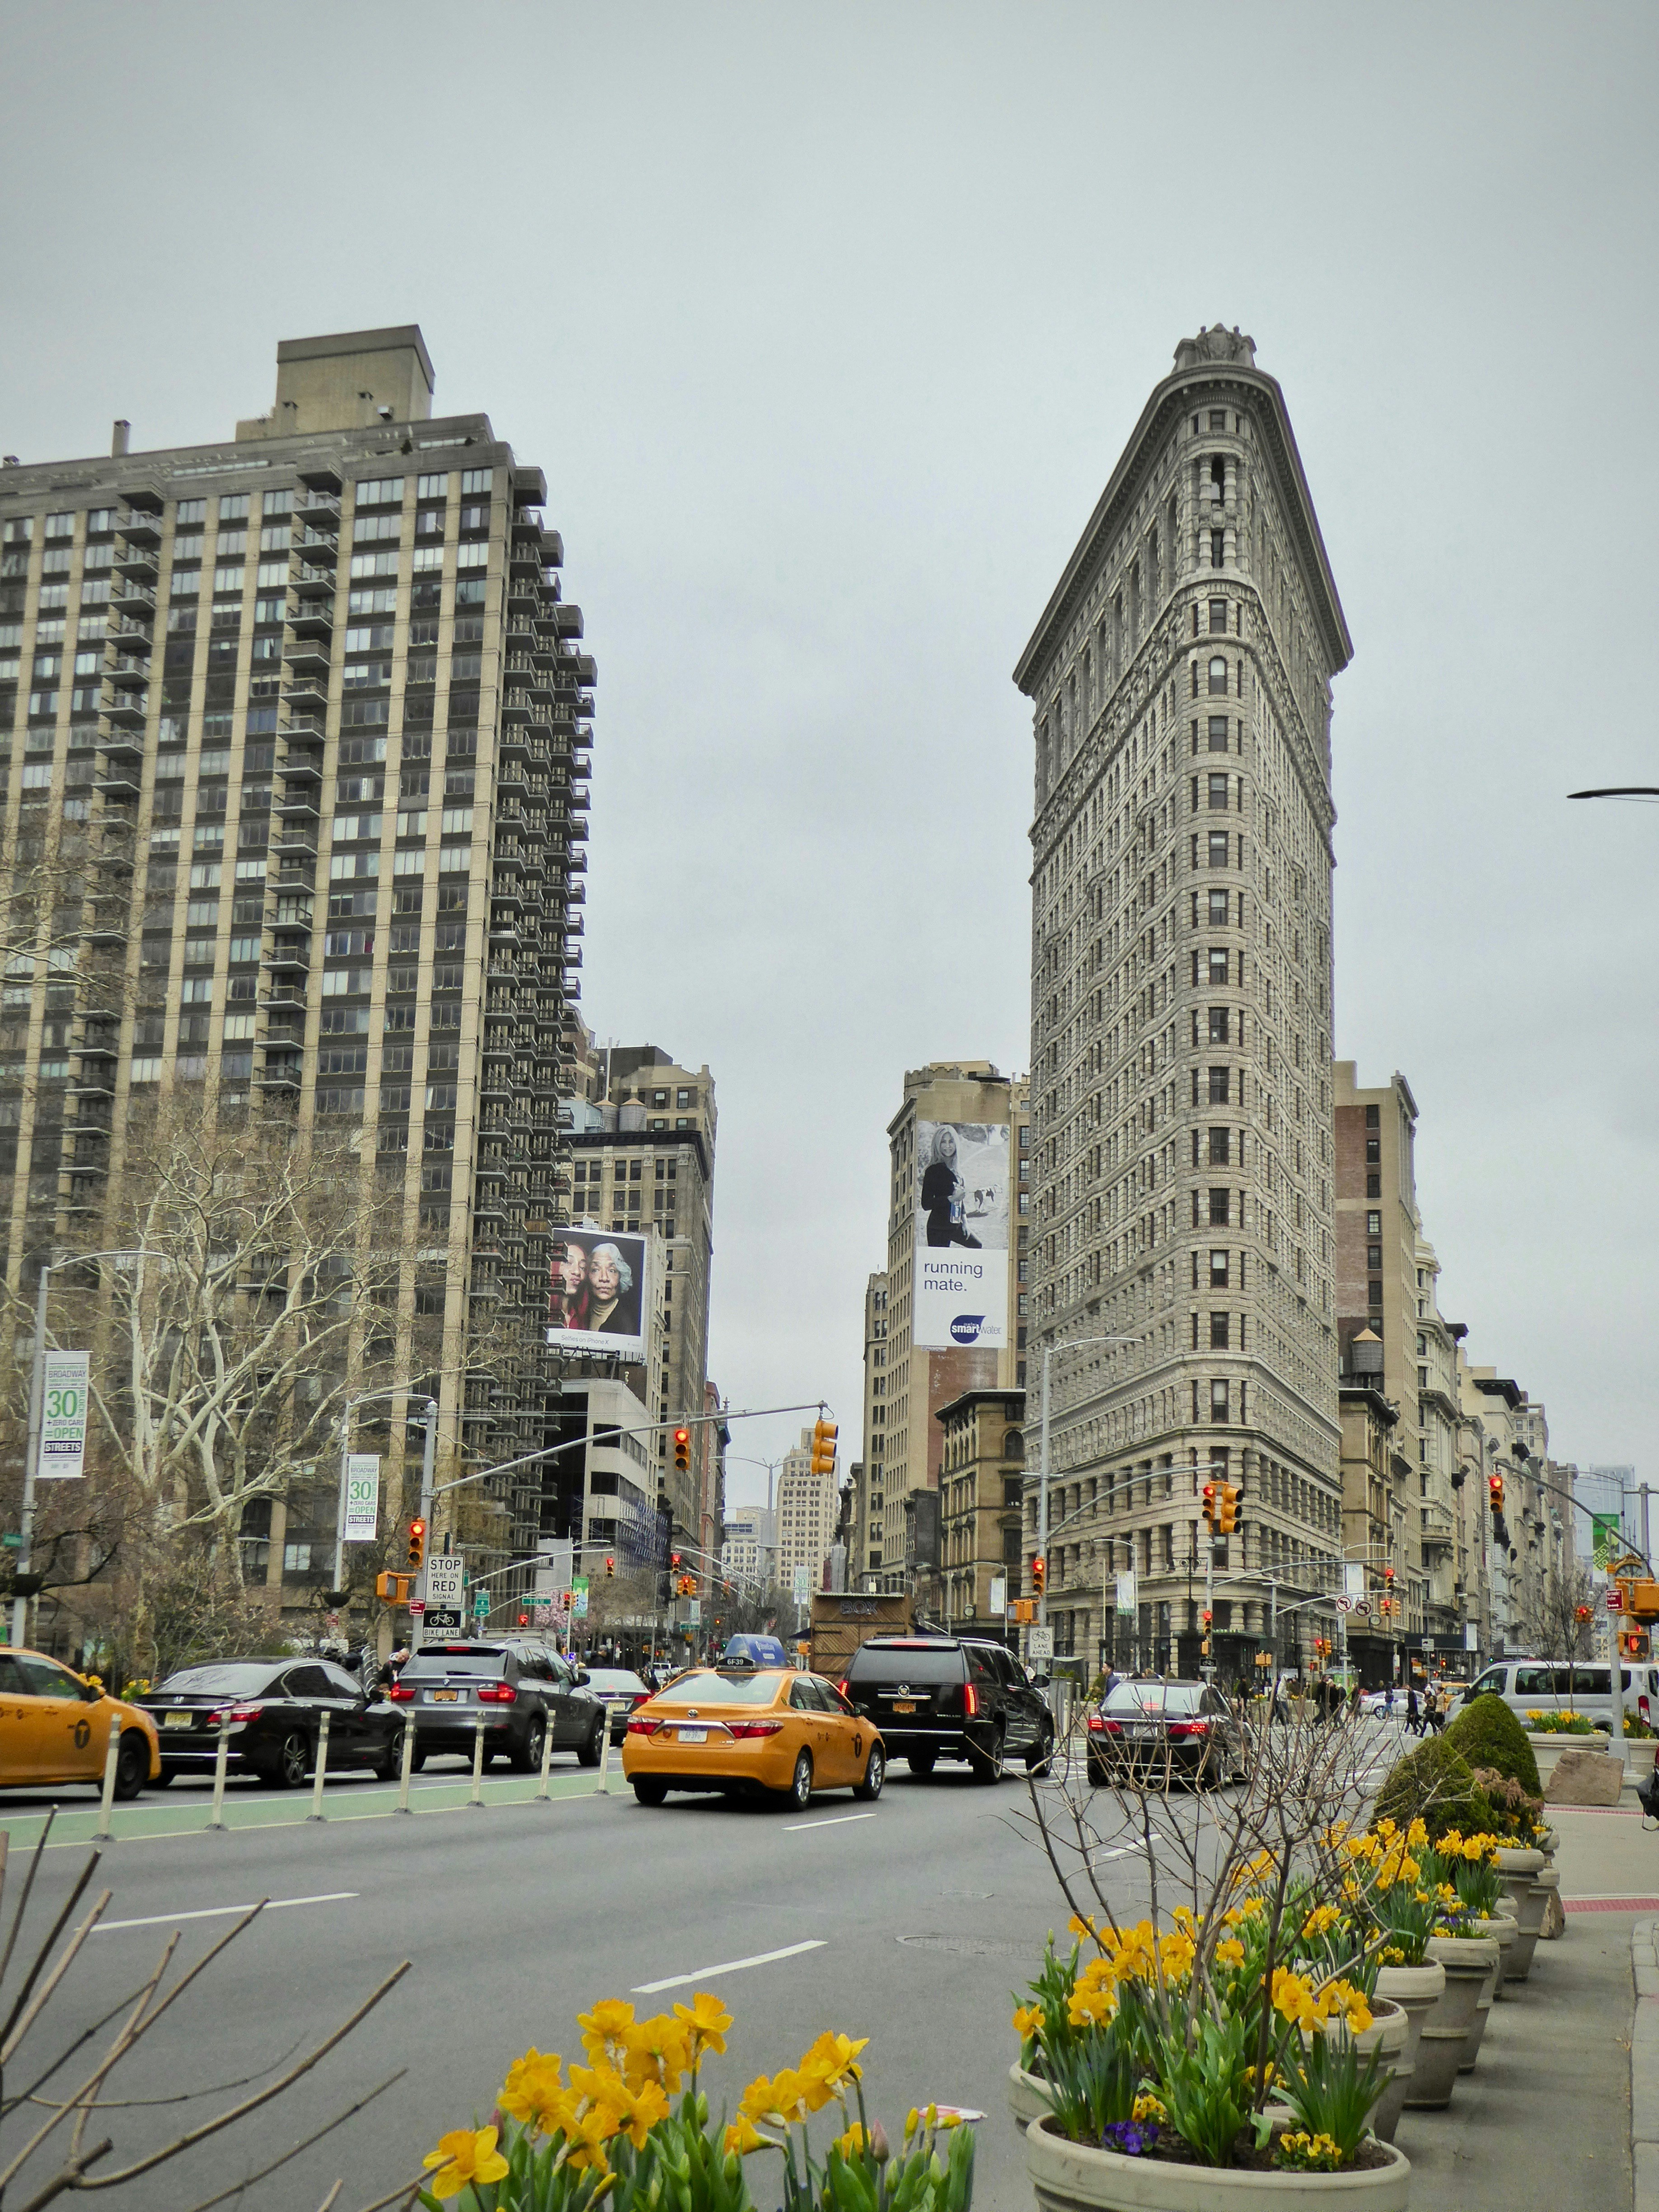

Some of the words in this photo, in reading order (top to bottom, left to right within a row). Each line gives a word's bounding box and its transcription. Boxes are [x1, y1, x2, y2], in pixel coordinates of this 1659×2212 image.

[924, 1261, 982, 1278] running
[924, 1279, 967, 1291] mate.
[47, 1390, 77, 1418] 30
[45, 1442, 81, 1452] STREETS
[350, 1481, 371, 1500] 30
[431, 1560, 461, 1570] STOP
[432, 1581, 456, 1591] RED
[796, 1577, 806, 1586] 30
[840, 1600, 878, 1615] BOX
